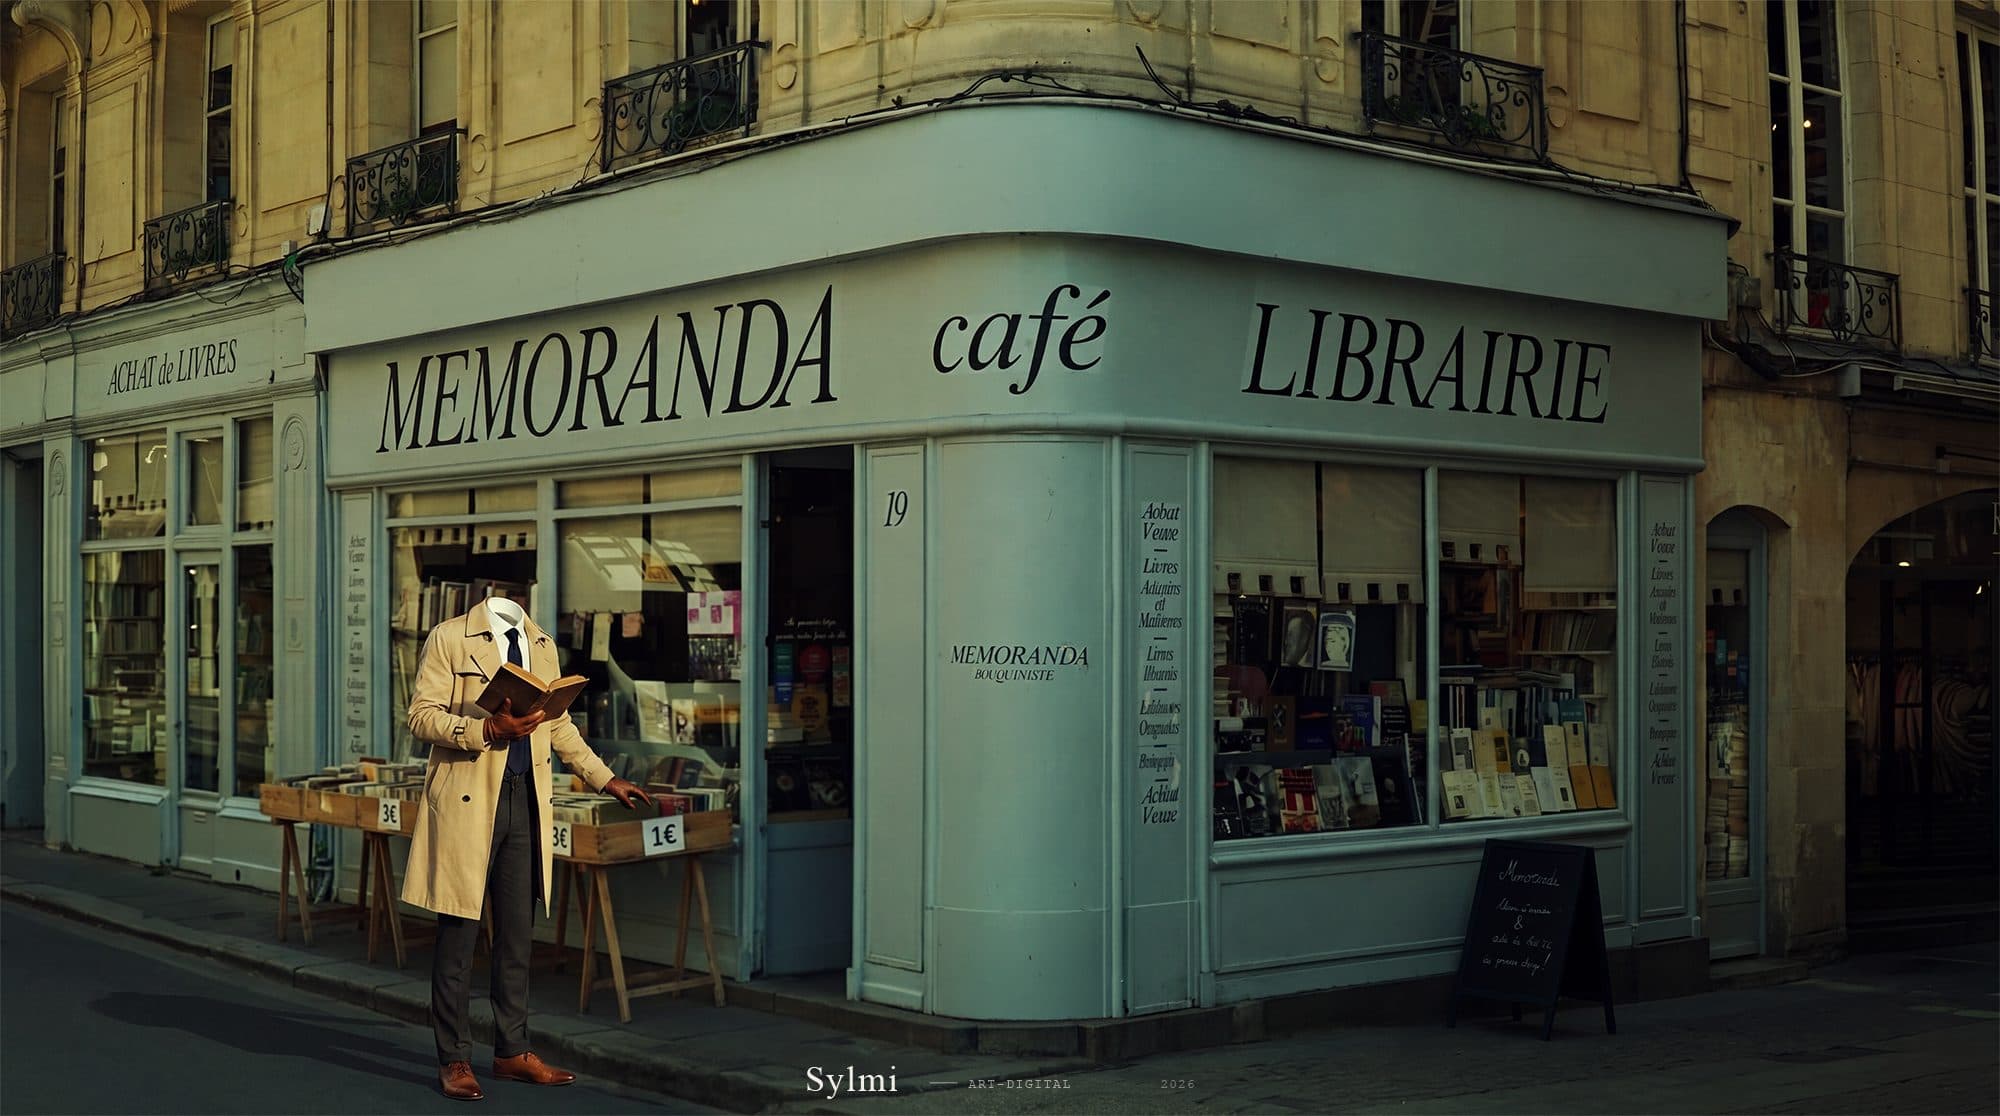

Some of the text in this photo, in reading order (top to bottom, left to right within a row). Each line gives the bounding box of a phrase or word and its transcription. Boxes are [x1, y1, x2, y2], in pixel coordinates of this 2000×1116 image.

[932, 284, 1112, 394] café
[107, 338, 237, 395] ACHAT de LIVRES
[376, 284, 838, 454] MEMORANDA
[1242, 302, 1612, 424] LIBRAIRIE
[884, 490, 909, 527] 19
[951, 645, 1089, 666] MEMORANDA
[975, 669, 1055, 684] BOUQUINISTE
[383, 803, 398, 824] 3€
[552, 825, 568, 849] 3€
[652, 823, 678, 847] 1€
